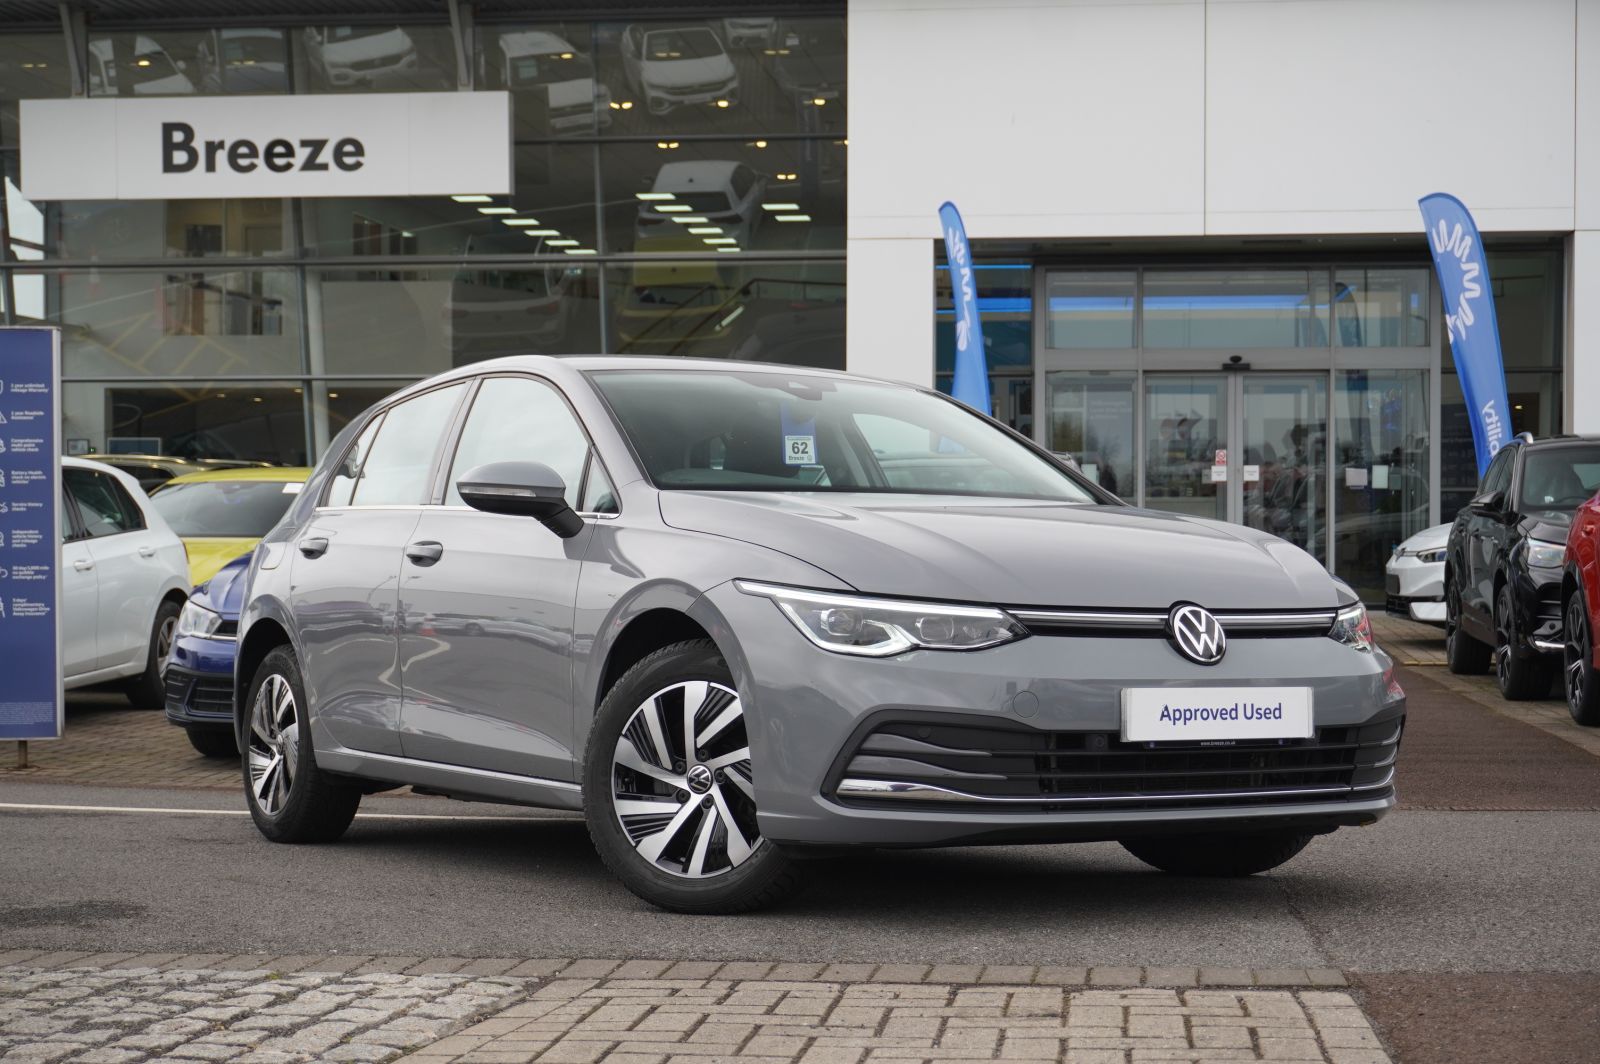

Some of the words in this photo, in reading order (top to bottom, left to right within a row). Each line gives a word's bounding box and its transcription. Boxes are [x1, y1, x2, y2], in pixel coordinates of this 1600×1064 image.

[162, 122, 365, 173] Breeze
[792, 441, 809, 455] 62
[1159, 703, 1239, 726] Approved
[1243, 702, 1283, 721] Used
